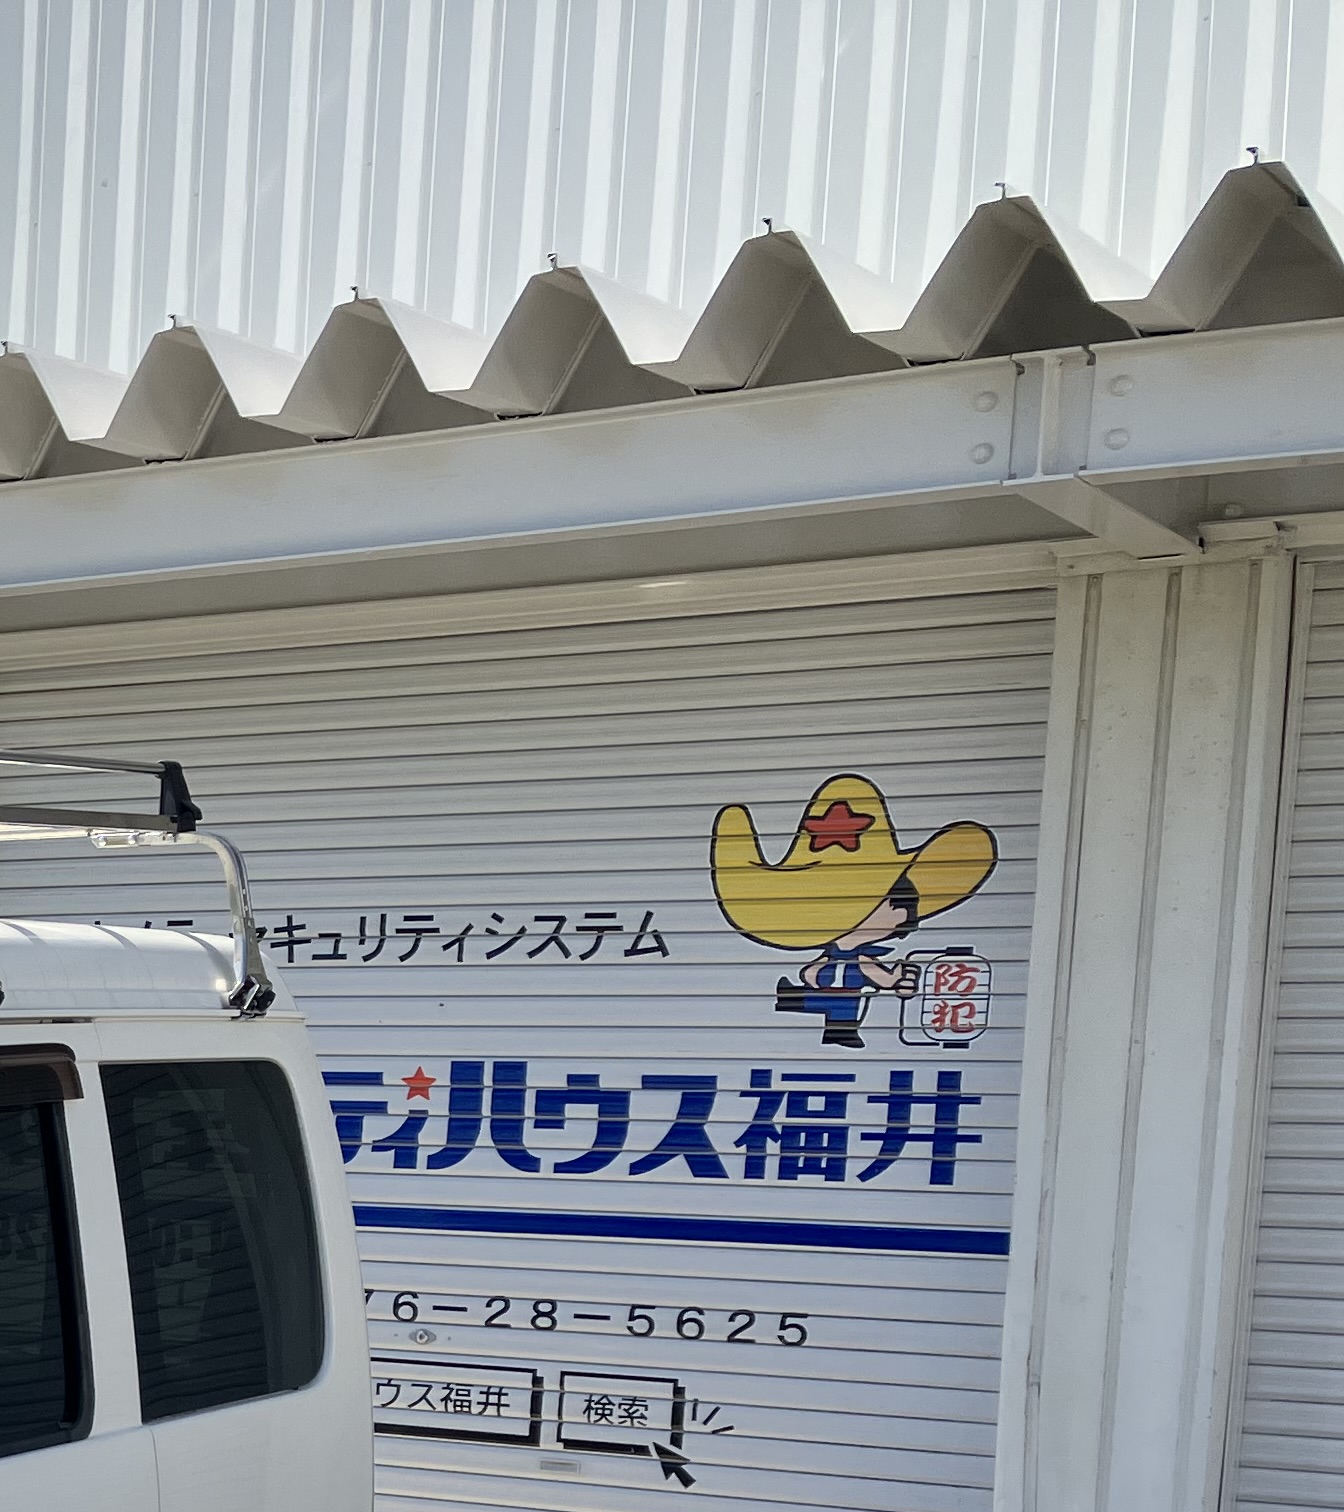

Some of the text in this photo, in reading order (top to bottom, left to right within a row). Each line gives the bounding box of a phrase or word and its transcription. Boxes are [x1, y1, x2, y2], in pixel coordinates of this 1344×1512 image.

[932, 963, 980, 1033] 防犯
[375, 1376, 511, 1417] ウス福井
[582, 1392, 650, 1427] 検索
